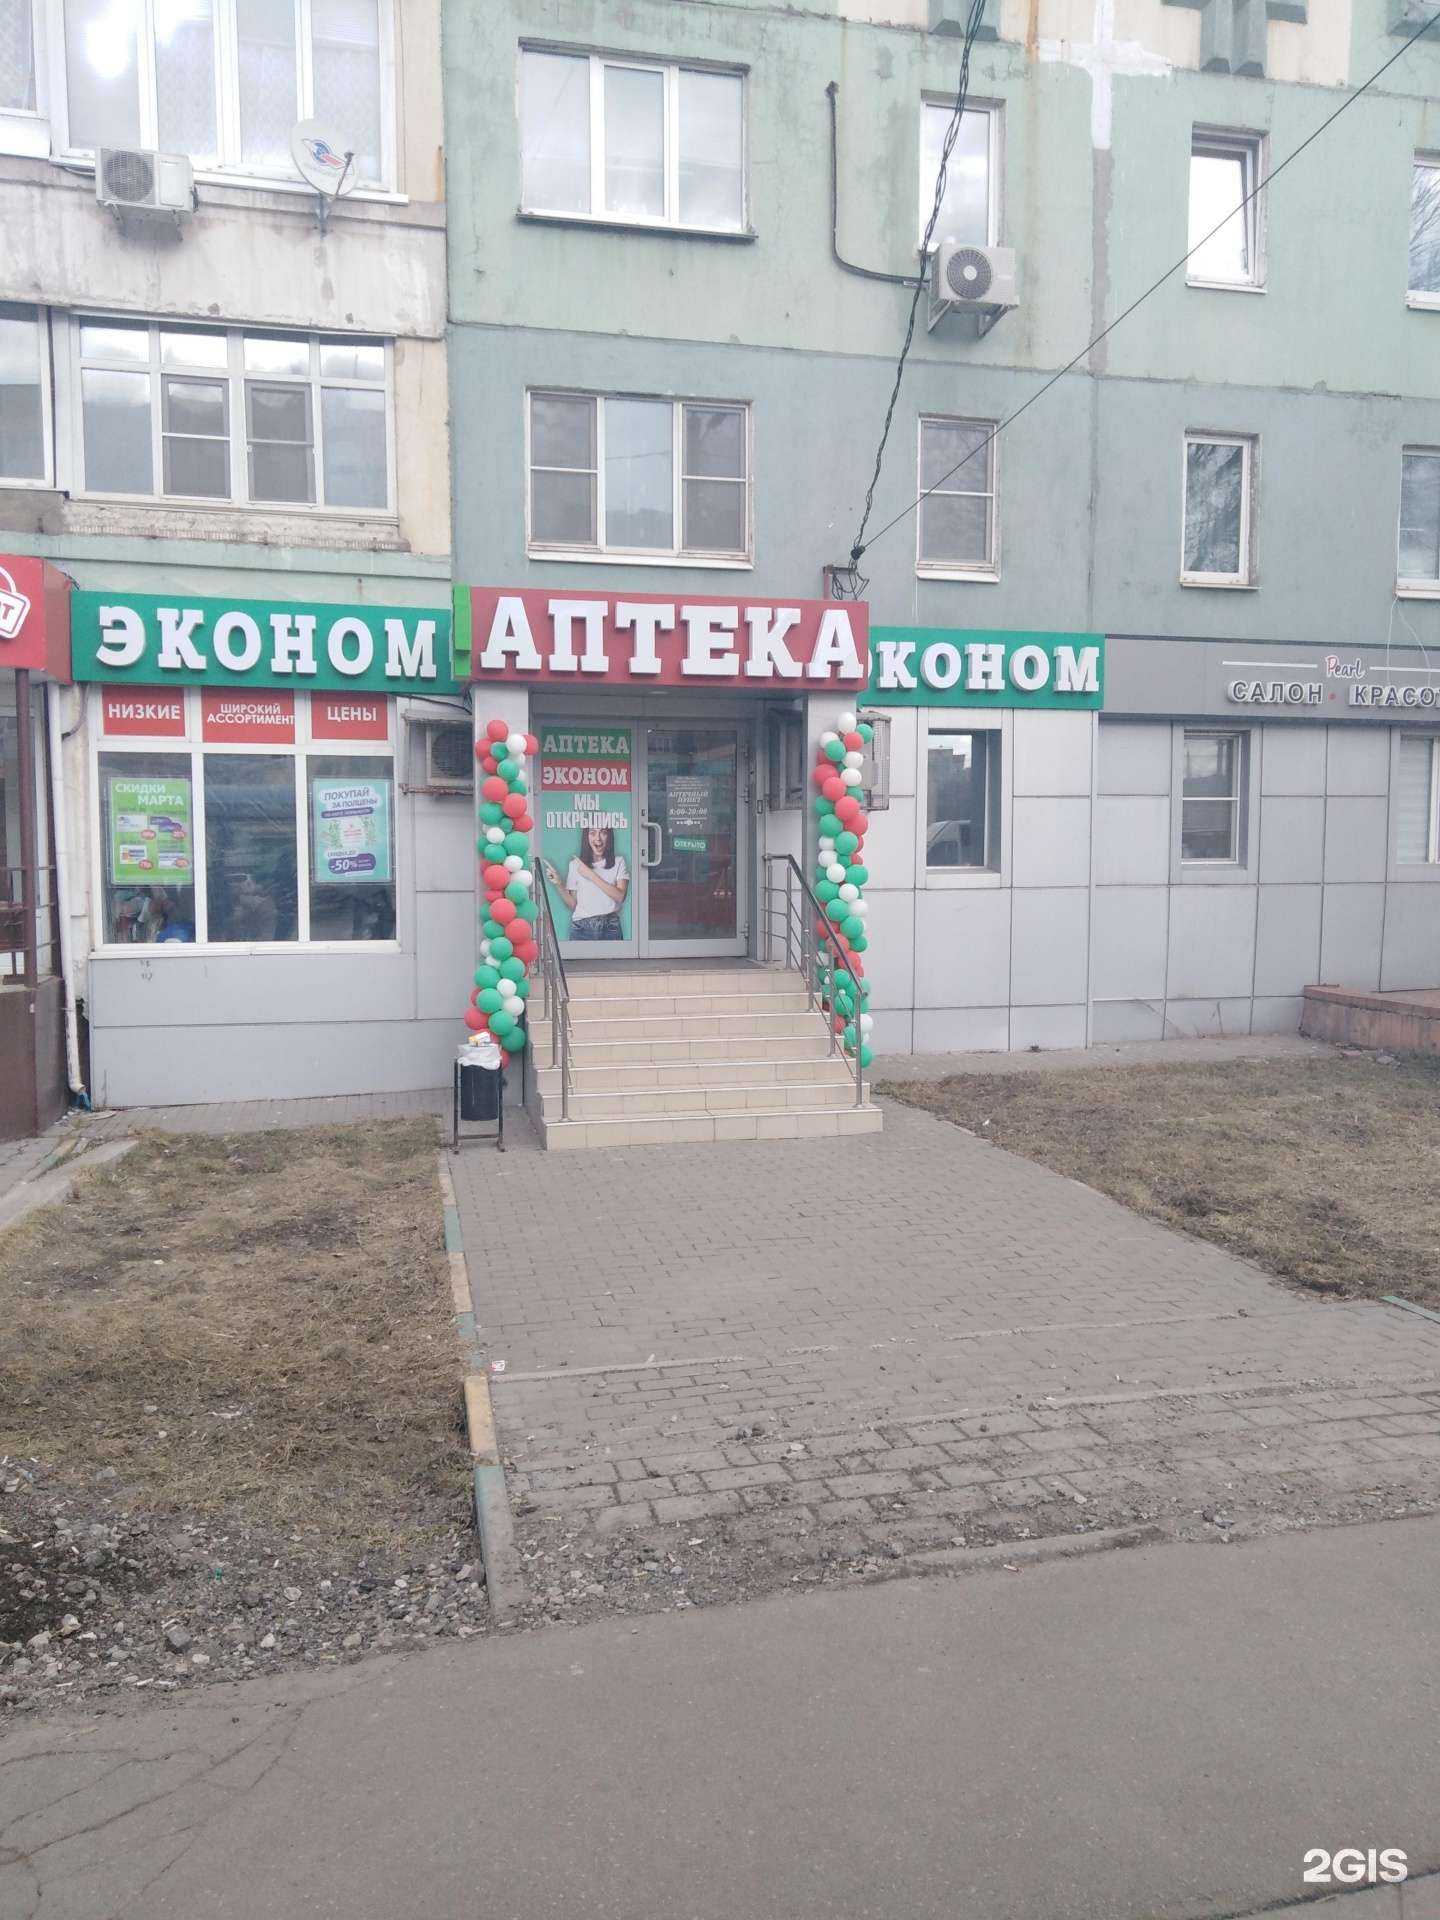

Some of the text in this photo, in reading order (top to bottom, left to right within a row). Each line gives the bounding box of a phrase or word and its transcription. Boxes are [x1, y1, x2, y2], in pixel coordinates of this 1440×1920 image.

[95, 605, 437, 678] ЭКОНОМ
[480, 596, 864, 679] АПТЕКА
[868, 641, 1100, 693] КОНОМ
[1325, 655, 1365, 678] Pearl
[1231, 681, 1324, 703] САЛОН
[108, 704, 181, 720] НИЗКИЕ
[220, 703, 281, 715] ШИРОКИЙ
[327, 706, 377, 723] ЦЕНЫ
[206, 713, 296, 725] АССОРТИМЕНТ
[543, 735, 630, 754] АПТЕКА
[542, 766, 628, 786] ЭКОНОМ
[115, 783, 166, 794] СКИДКИ
[324, 787, 370, 801] ПОКУПАЙ
[137, 795, 185, 806] МАРТА
[574, 793, 600, 811] МЫ
[546, 811, 628, 829] ОТКРЫЛИСЬ
